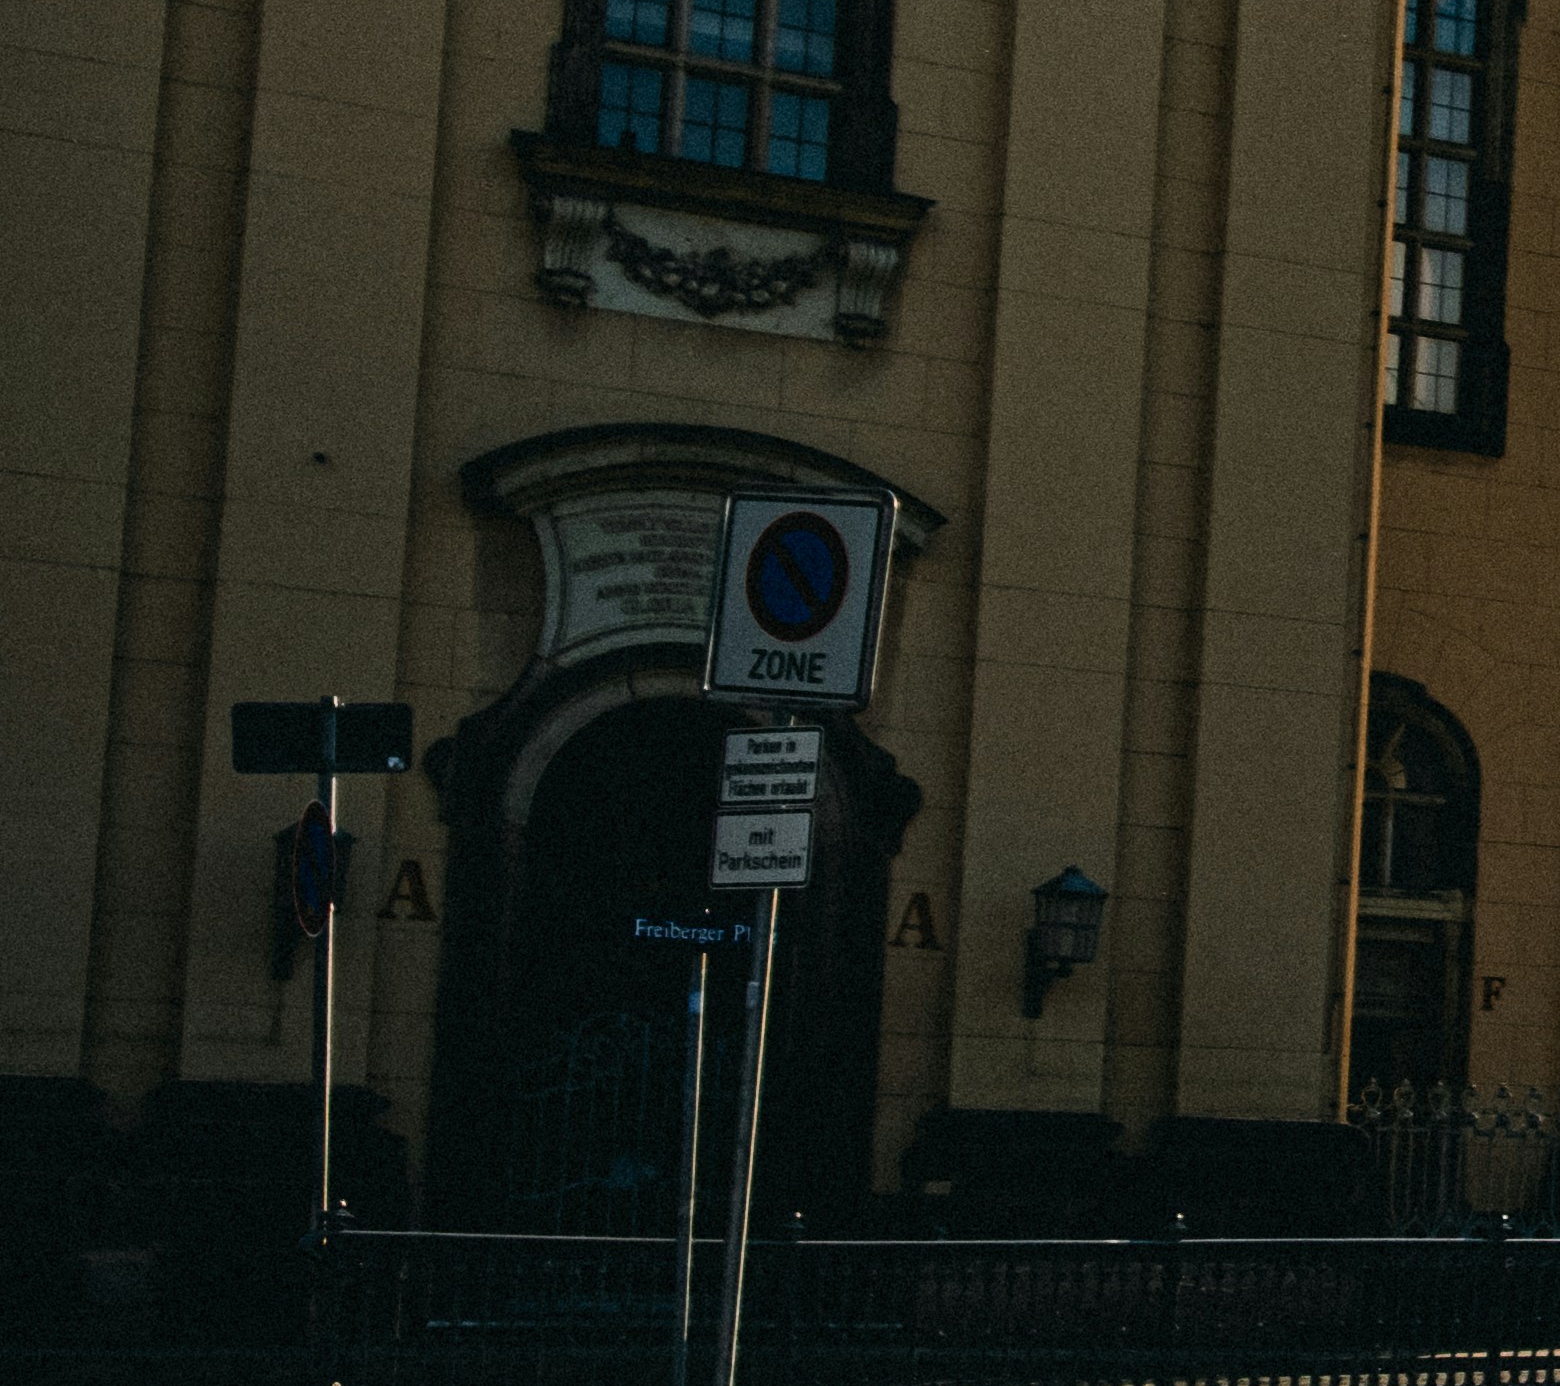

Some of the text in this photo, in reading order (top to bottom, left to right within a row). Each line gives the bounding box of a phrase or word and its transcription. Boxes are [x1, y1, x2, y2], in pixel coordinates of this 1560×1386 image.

[748, 648, 826, 684] ZONE
[749, 826, 773, 845] mit
[718, 851, 802, 871] Parkschein
[378, 859, 437, 922] A
[635, 918, 725, 943] Freiberger
[890, 892, 942, 950] A
[1480, 976, 1506, 1011] F
